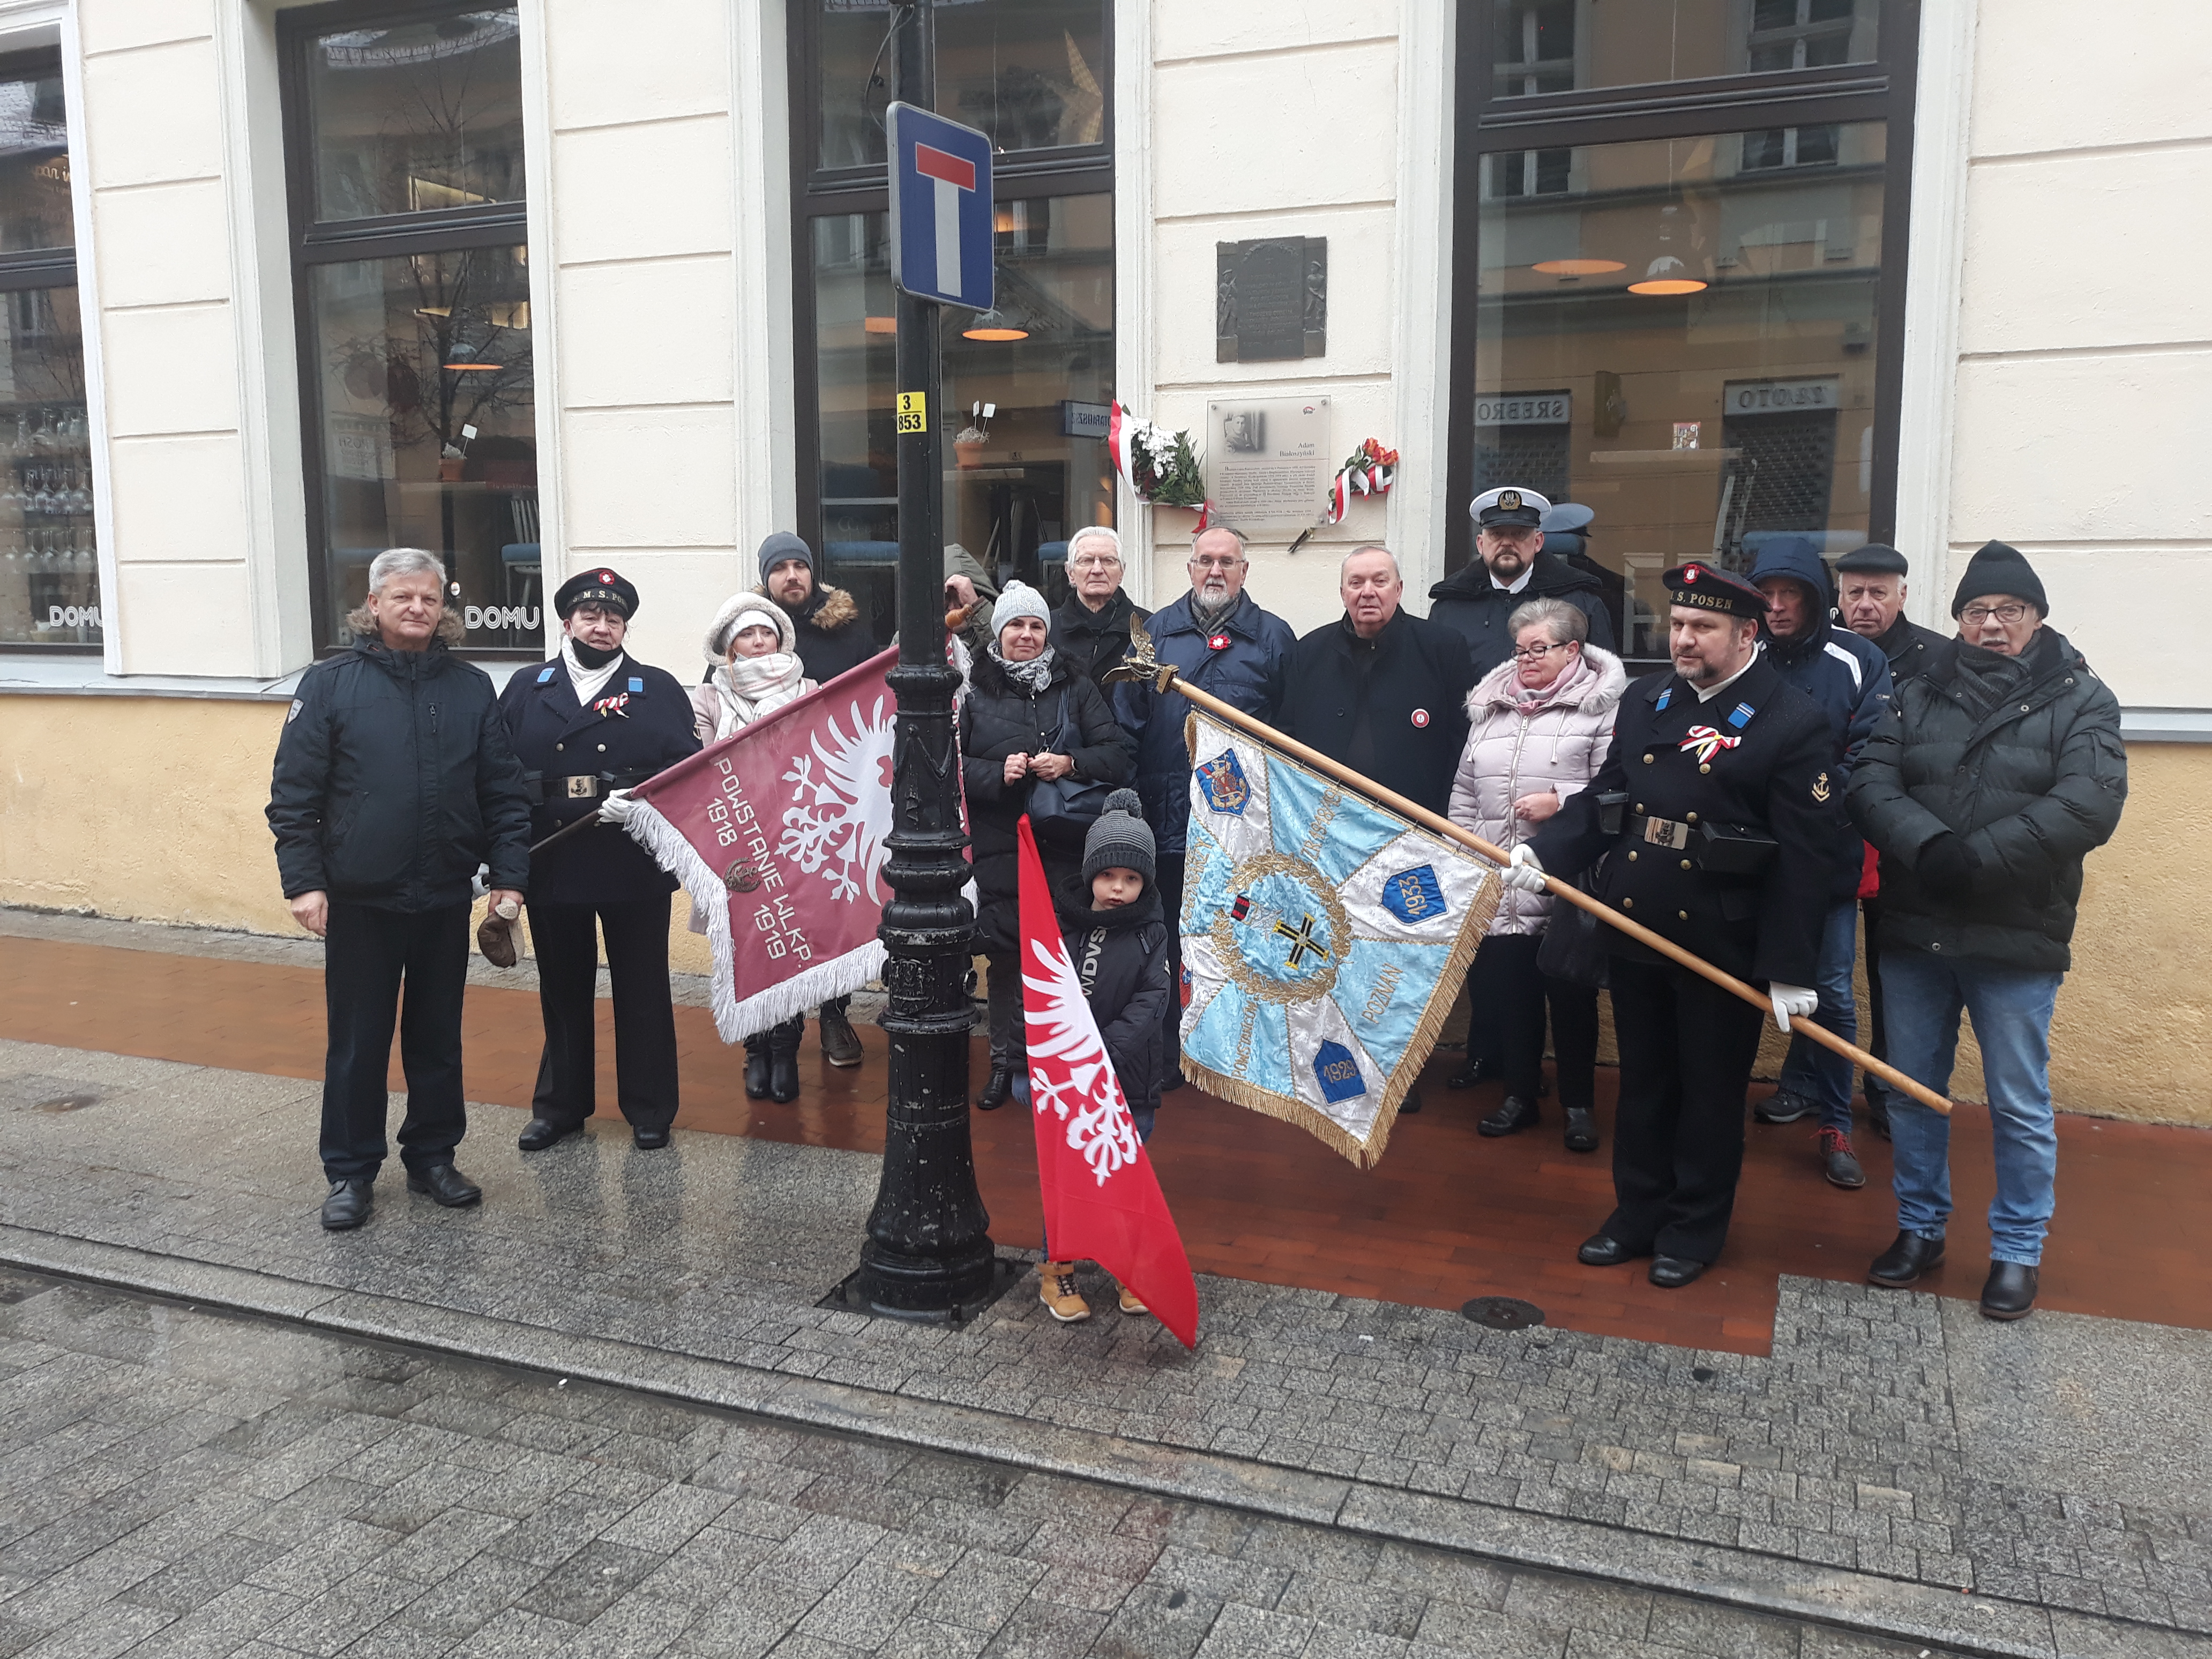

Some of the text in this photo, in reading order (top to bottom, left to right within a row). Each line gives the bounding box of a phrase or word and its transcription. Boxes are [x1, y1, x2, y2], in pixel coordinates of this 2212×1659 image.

[903, 394, 911, 410] 3
[899, 414, 922, 431] 853
[598, 590, 609, 599] S.
[1677, 591, 1686, 602] S.
[1690, 593, 1733, 610] POSEN
[465, 606, 540, 630] DOMU
[707, 797, 738, 847] 1918
[713, 757, 812, 969] POWSTANIE WLKP.
[1399, 875, 1428, 915] 1933
[753, 904, 787, 960] 1919
[1323, 1059, 1356, 1083] 1929
